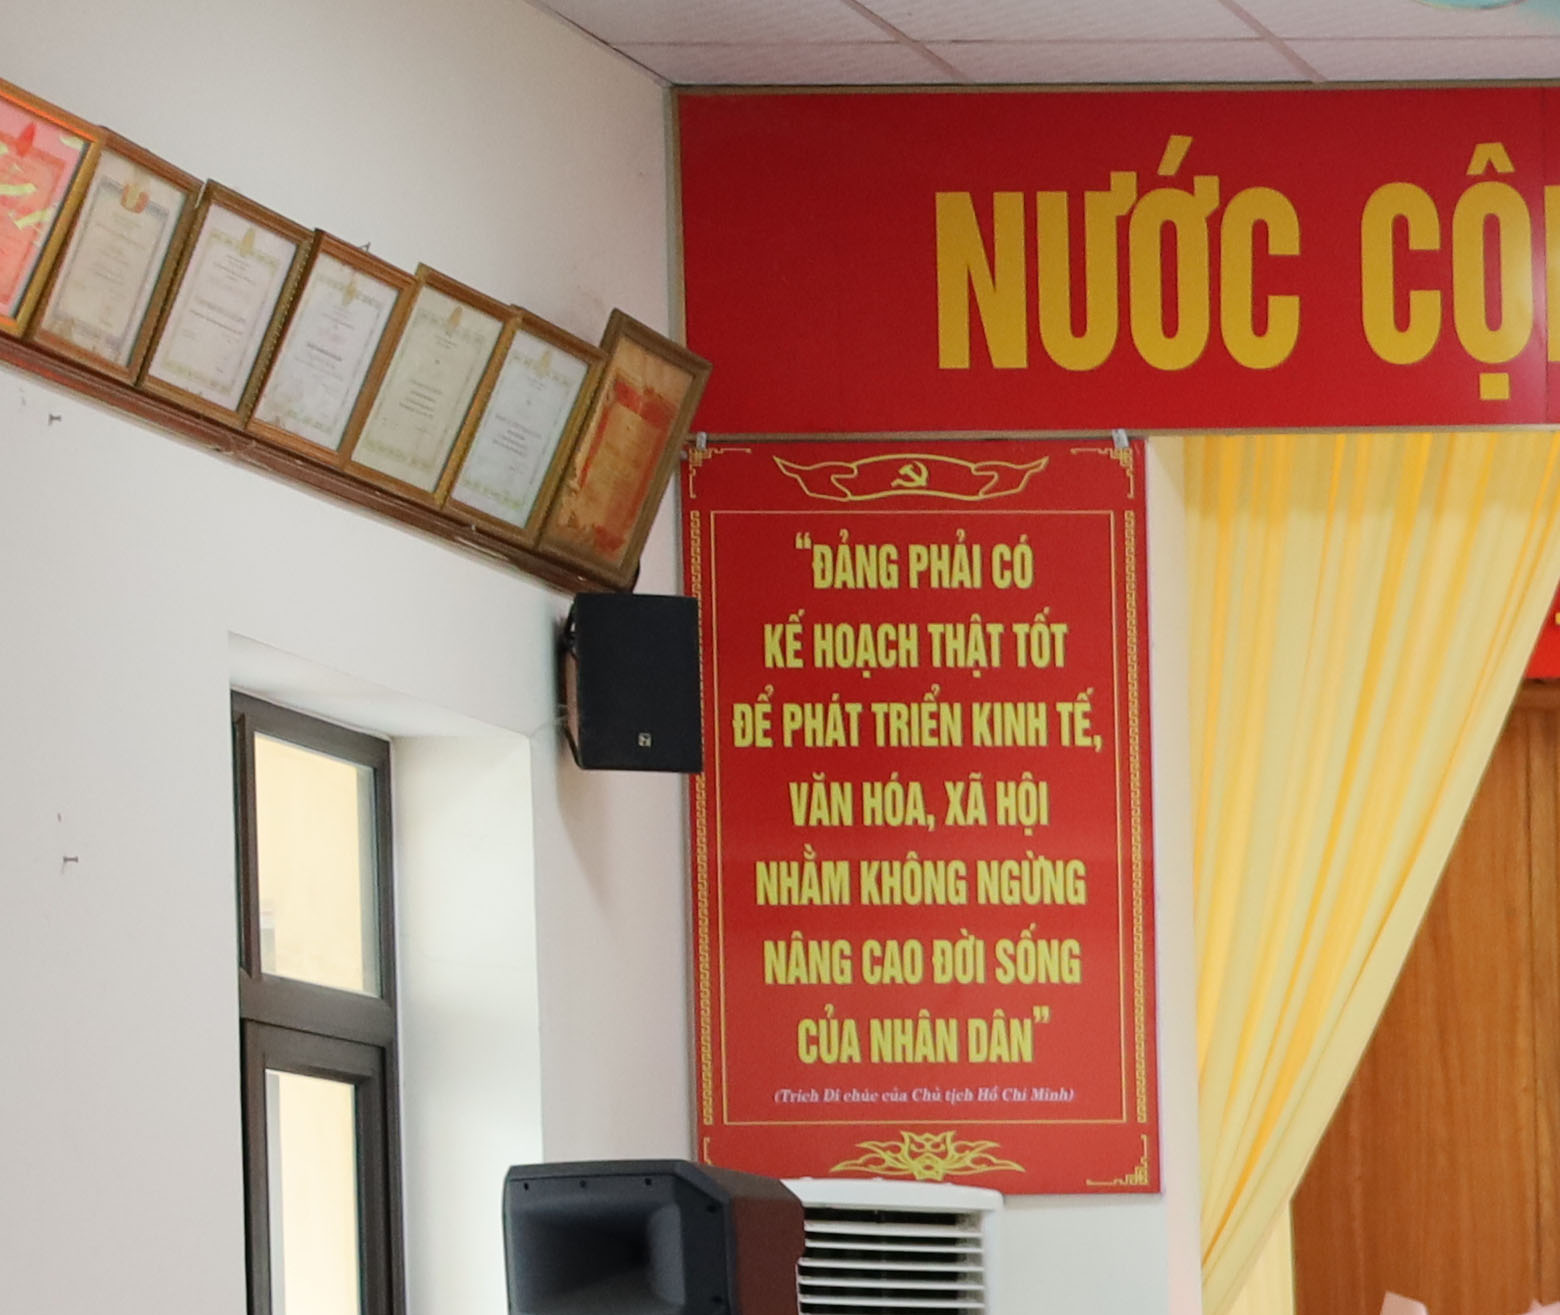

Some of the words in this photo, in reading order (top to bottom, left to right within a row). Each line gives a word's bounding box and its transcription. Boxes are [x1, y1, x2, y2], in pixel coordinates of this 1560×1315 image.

[936, 136, 1300, 371] NƯỚC
[796, 529, 898, 588] “ĐẢNG
[909, 529, 981, 588] PHẢI
[992, 535, 1033, 589] CÓ
[765, 610, 804, 668] KẾ
[814, 623, 918, 678] HOẠCH
[928, 614, 1004, 677] THẬT
[1013, 607, 1068, 668] TỐT
[733, 685, 773, 747] ĐỂ
[783, 694, 862, 747] PHÁT
[872, 684, 962, 746] TRIỂN
[973, 702, 1047, 746] KINH
[1056, 688, 1102, 752] TẾ,
[790, 773, 853, 826] VĂN
[863, 773, 935, 831] HÓA,
[945, 773, 987, 826] XÃ
[997, 772, 1048, 835] HỘI
[757, 844, 850, 905] NHẰM
[861, 851, 967, 905] KHÔNG
[978, 851, 1086, 905] NGỪNG
[798, 1004, 861, 1064] CỦA
[871, 1009, 958, 1063] NHÂN
[968, 1006, 1049, 1062] DÂN”
